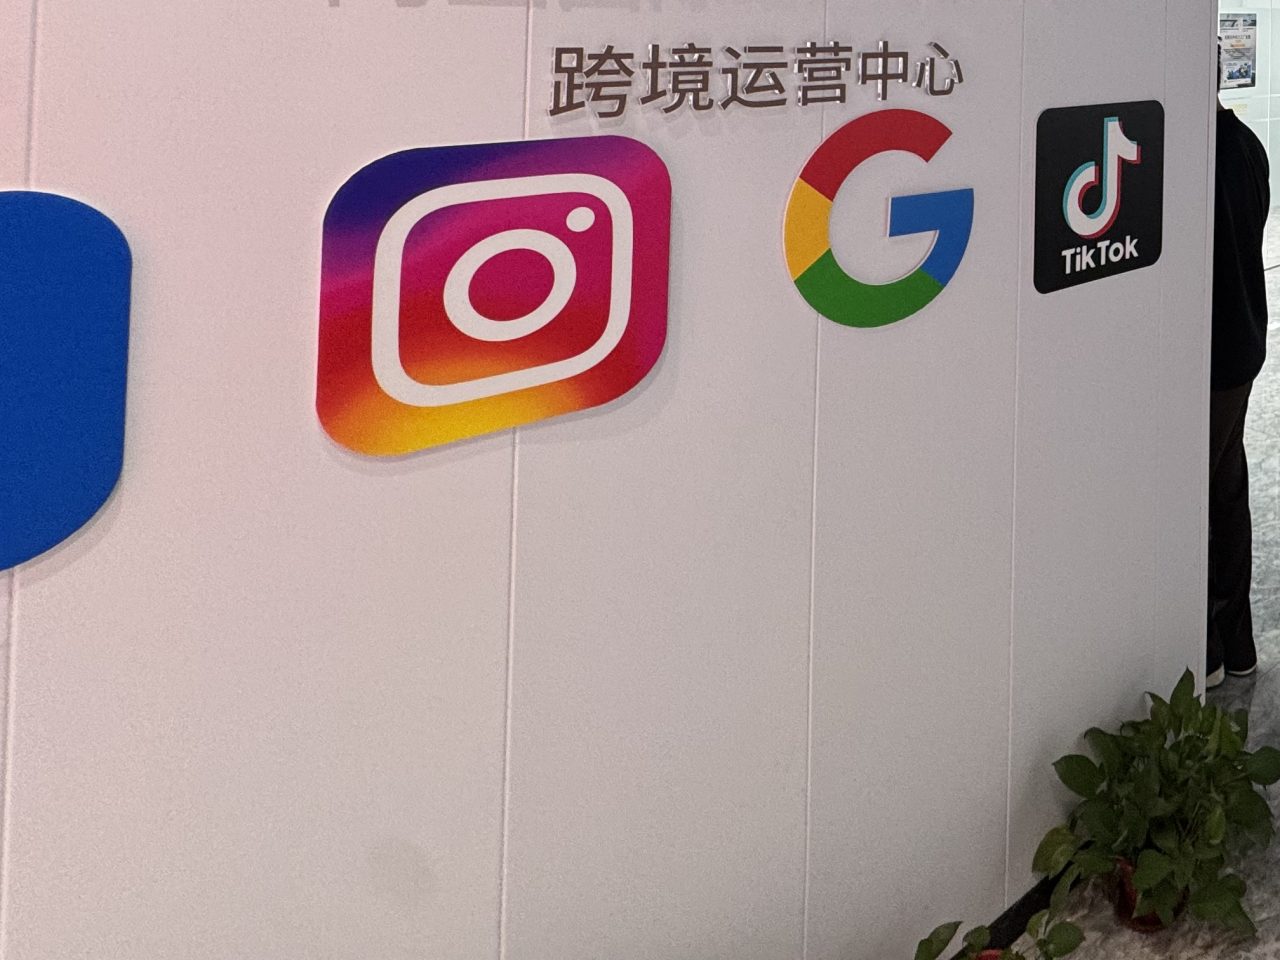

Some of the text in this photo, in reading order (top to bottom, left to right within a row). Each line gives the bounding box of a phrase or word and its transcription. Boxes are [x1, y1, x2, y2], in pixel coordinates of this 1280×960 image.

[548, 41, 964, 119] 跨境运营中心
[1061, 235, 1139, 275] TikTok
